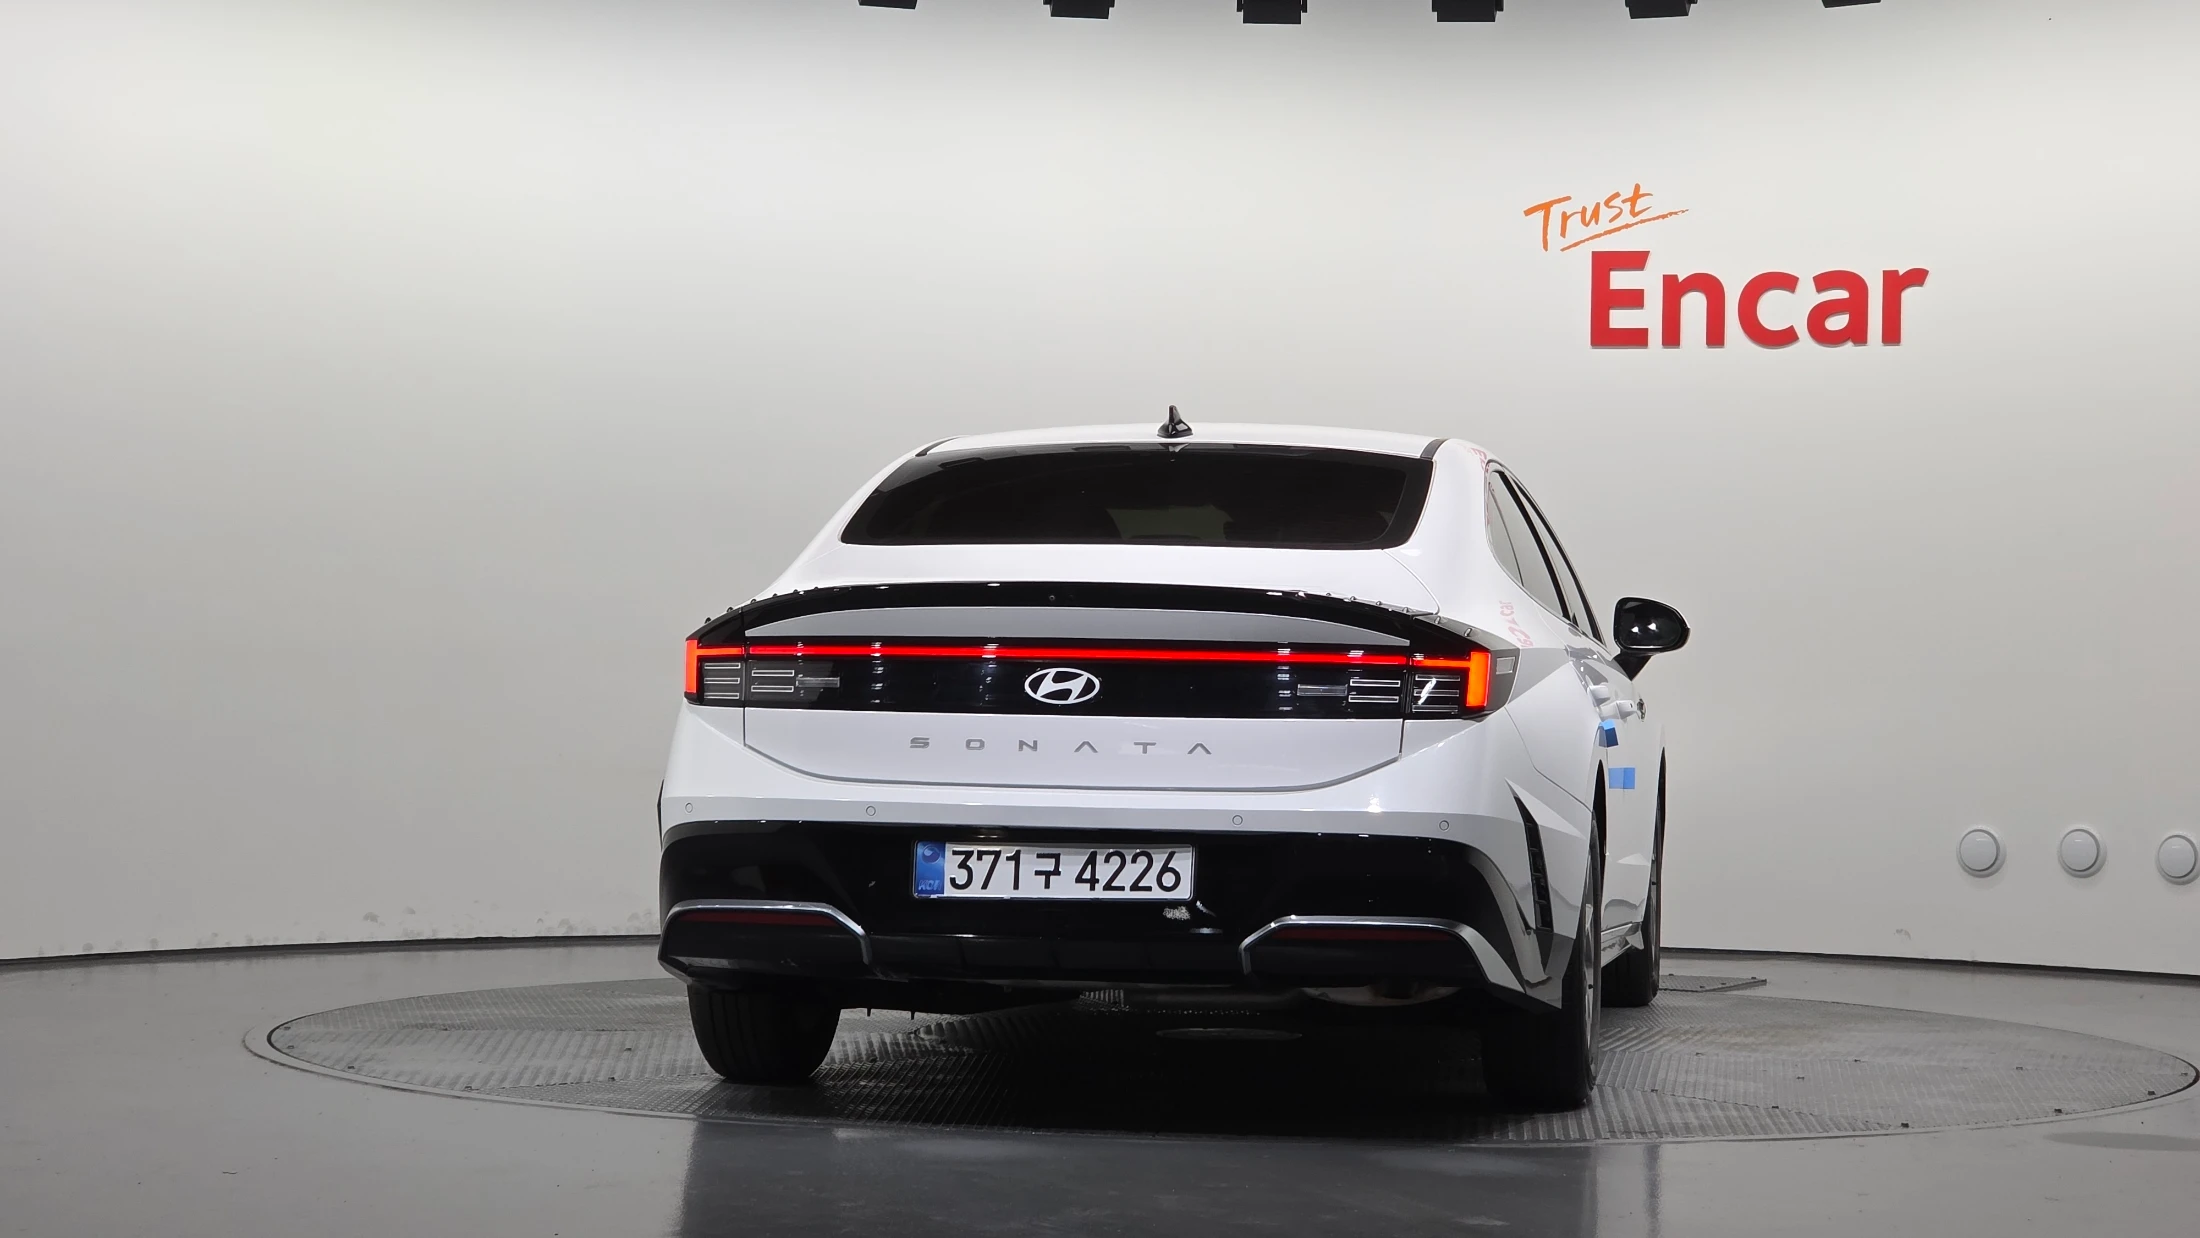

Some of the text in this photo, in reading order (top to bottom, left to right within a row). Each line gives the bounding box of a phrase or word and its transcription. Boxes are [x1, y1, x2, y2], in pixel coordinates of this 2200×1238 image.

[1523, 183, 1654, 252] Trust
[1590, 250, 1930, 349] Encar
[909, 736, 1213, 756] SONATA
[949, 848, 1182, 893] 371구 4226
